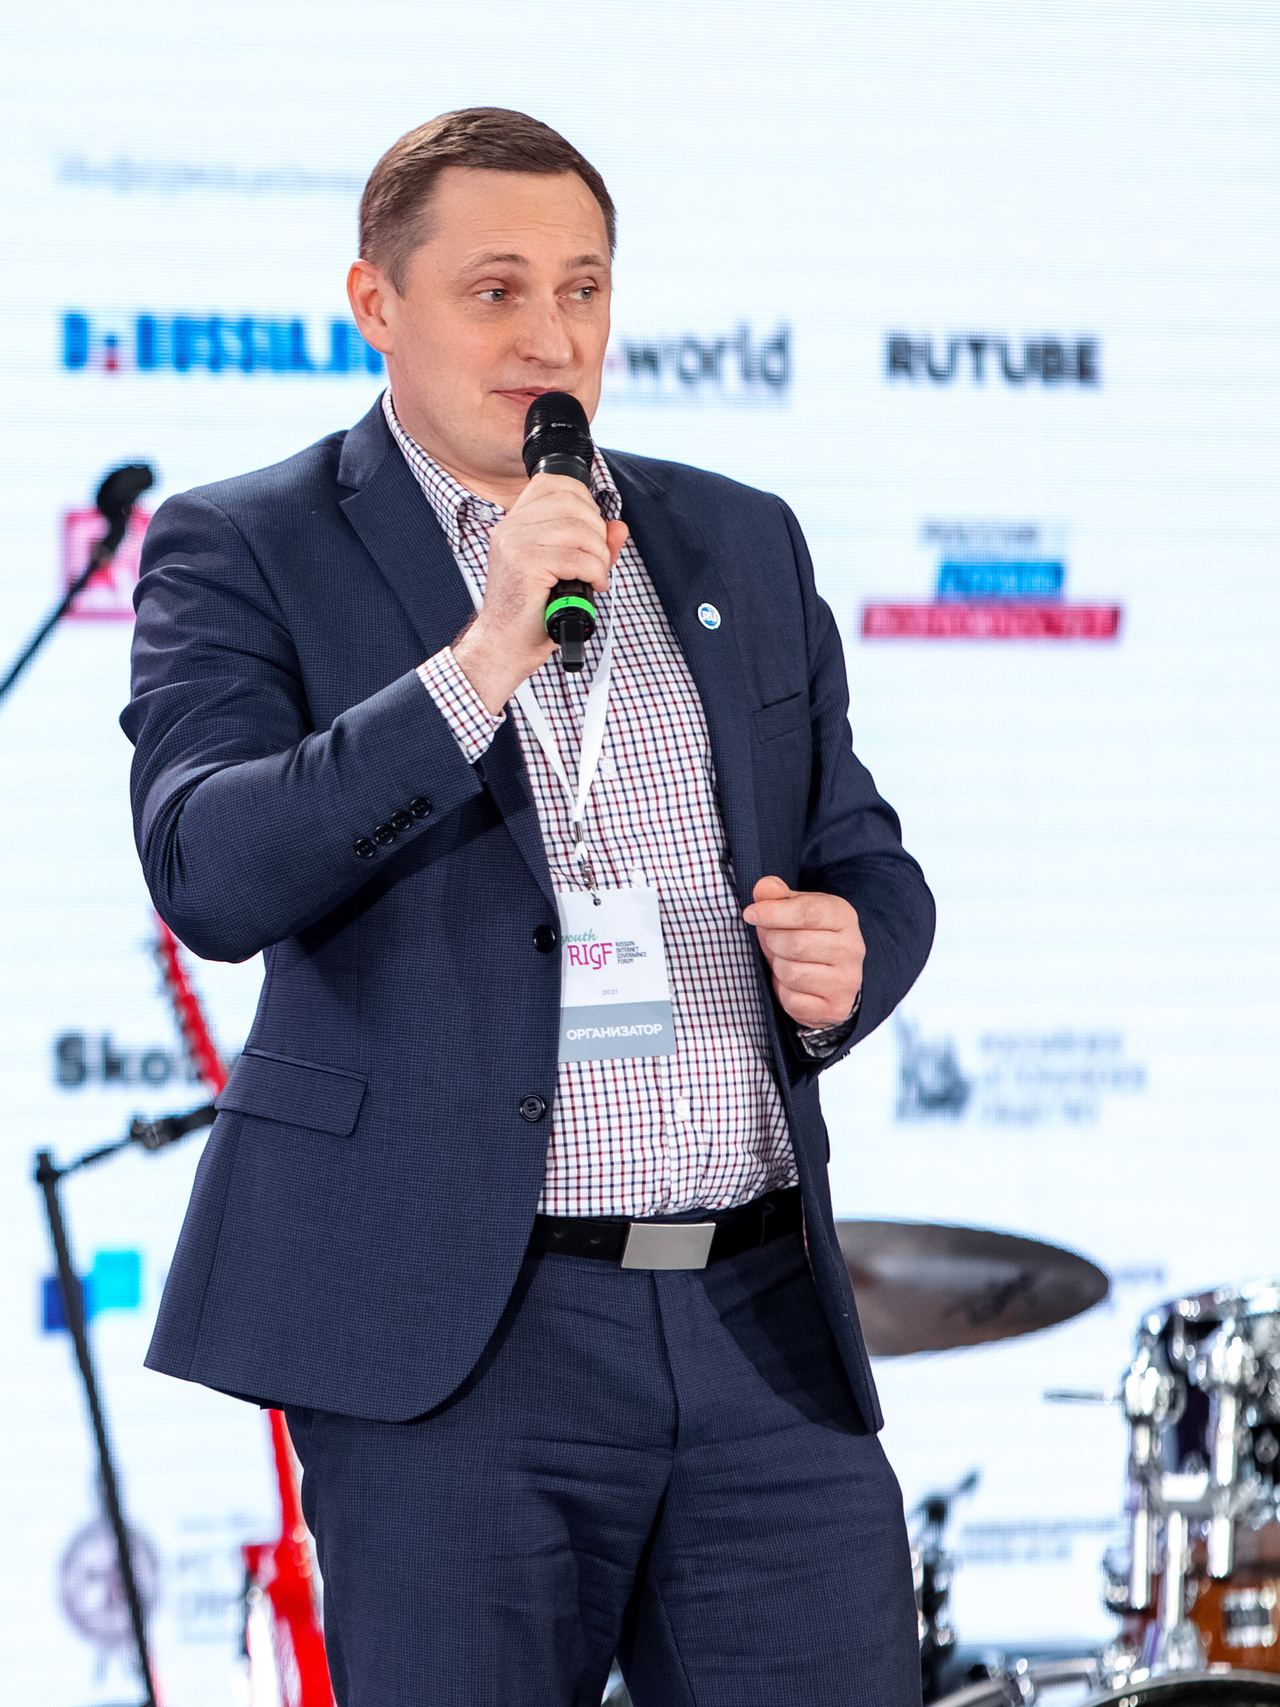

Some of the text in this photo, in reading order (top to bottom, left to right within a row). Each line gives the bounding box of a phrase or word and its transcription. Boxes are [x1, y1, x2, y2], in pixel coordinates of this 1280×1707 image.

[885, 334, 1102, 388] RUTUBE
[561, 928, 598, 946] youth
[567, 942, 613, 970] RIGF
[616, 951, 647, 959] GOVERNANCE
[566, 1023, 663, 1041] ОРГАНИЗАТОР
